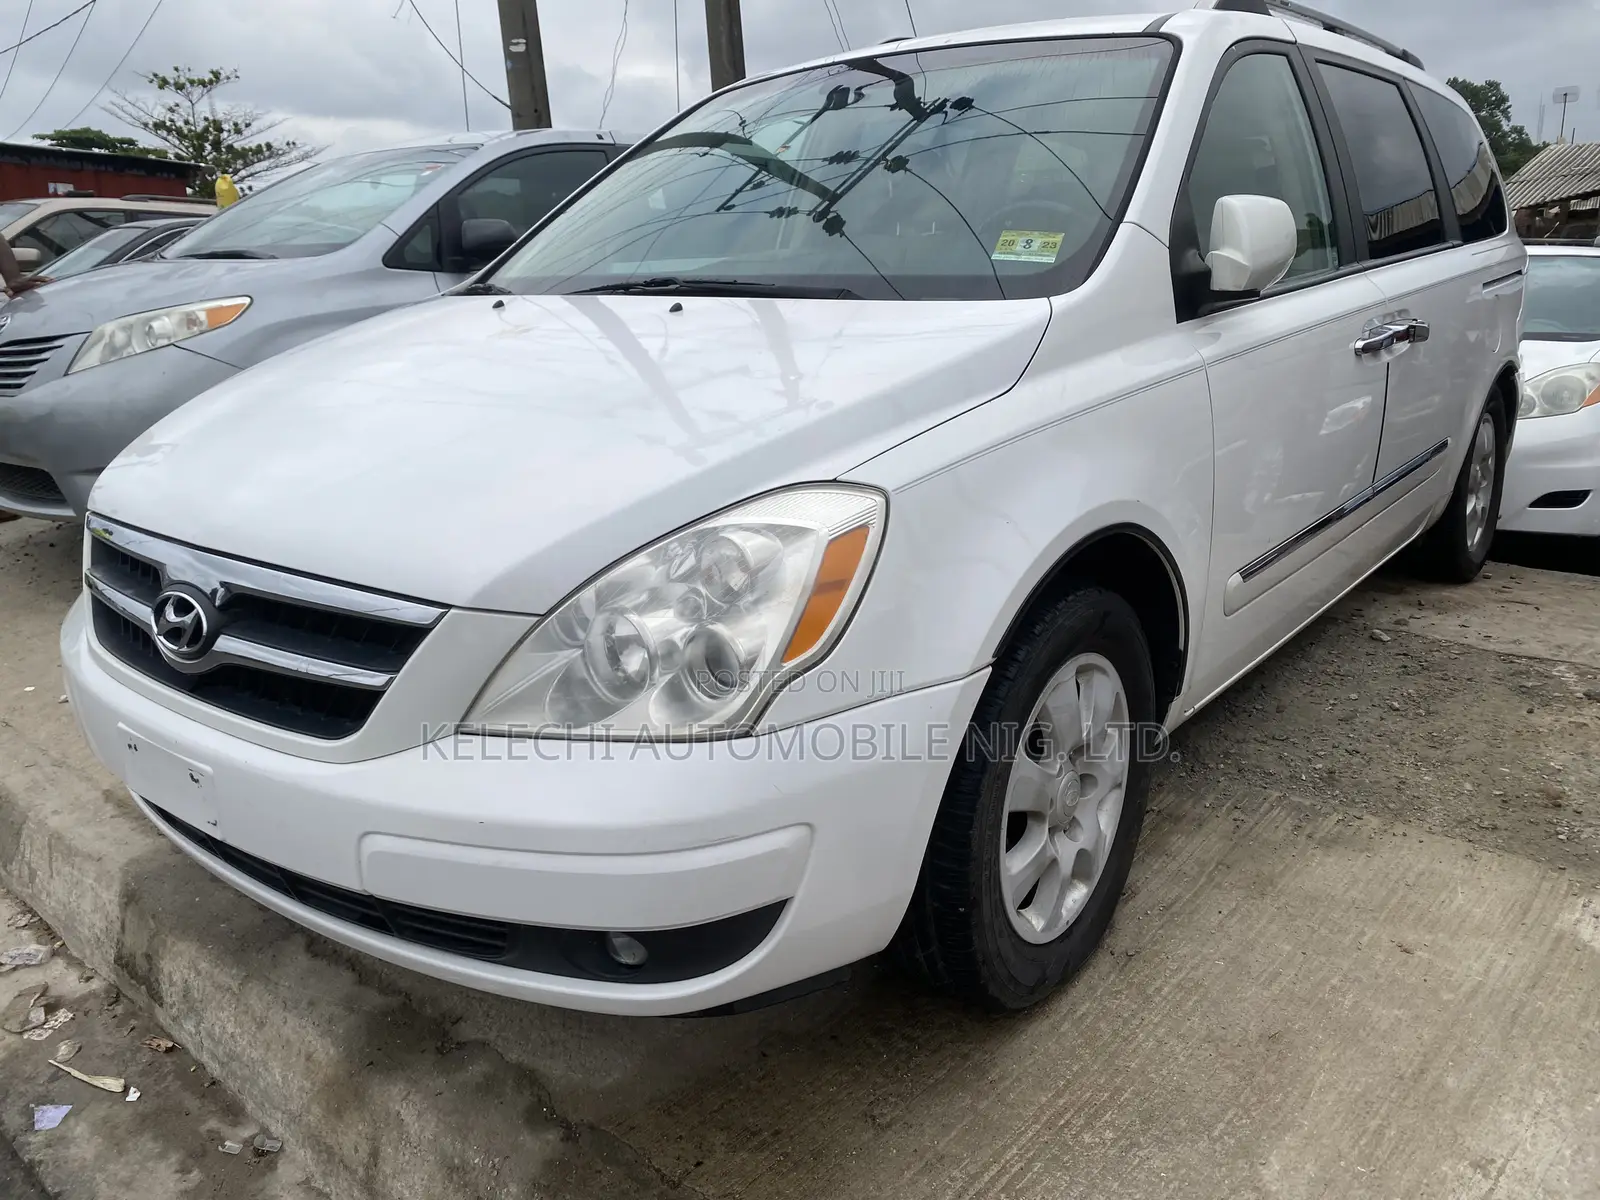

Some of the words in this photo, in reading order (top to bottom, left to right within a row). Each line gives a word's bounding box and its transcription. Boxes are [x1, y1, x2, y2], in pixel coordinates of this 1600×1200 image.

[1001, 239, 1015, 247] 20
[1023, 239, 1034, 249] 8
[1042, 241, 1058, 249] 23
